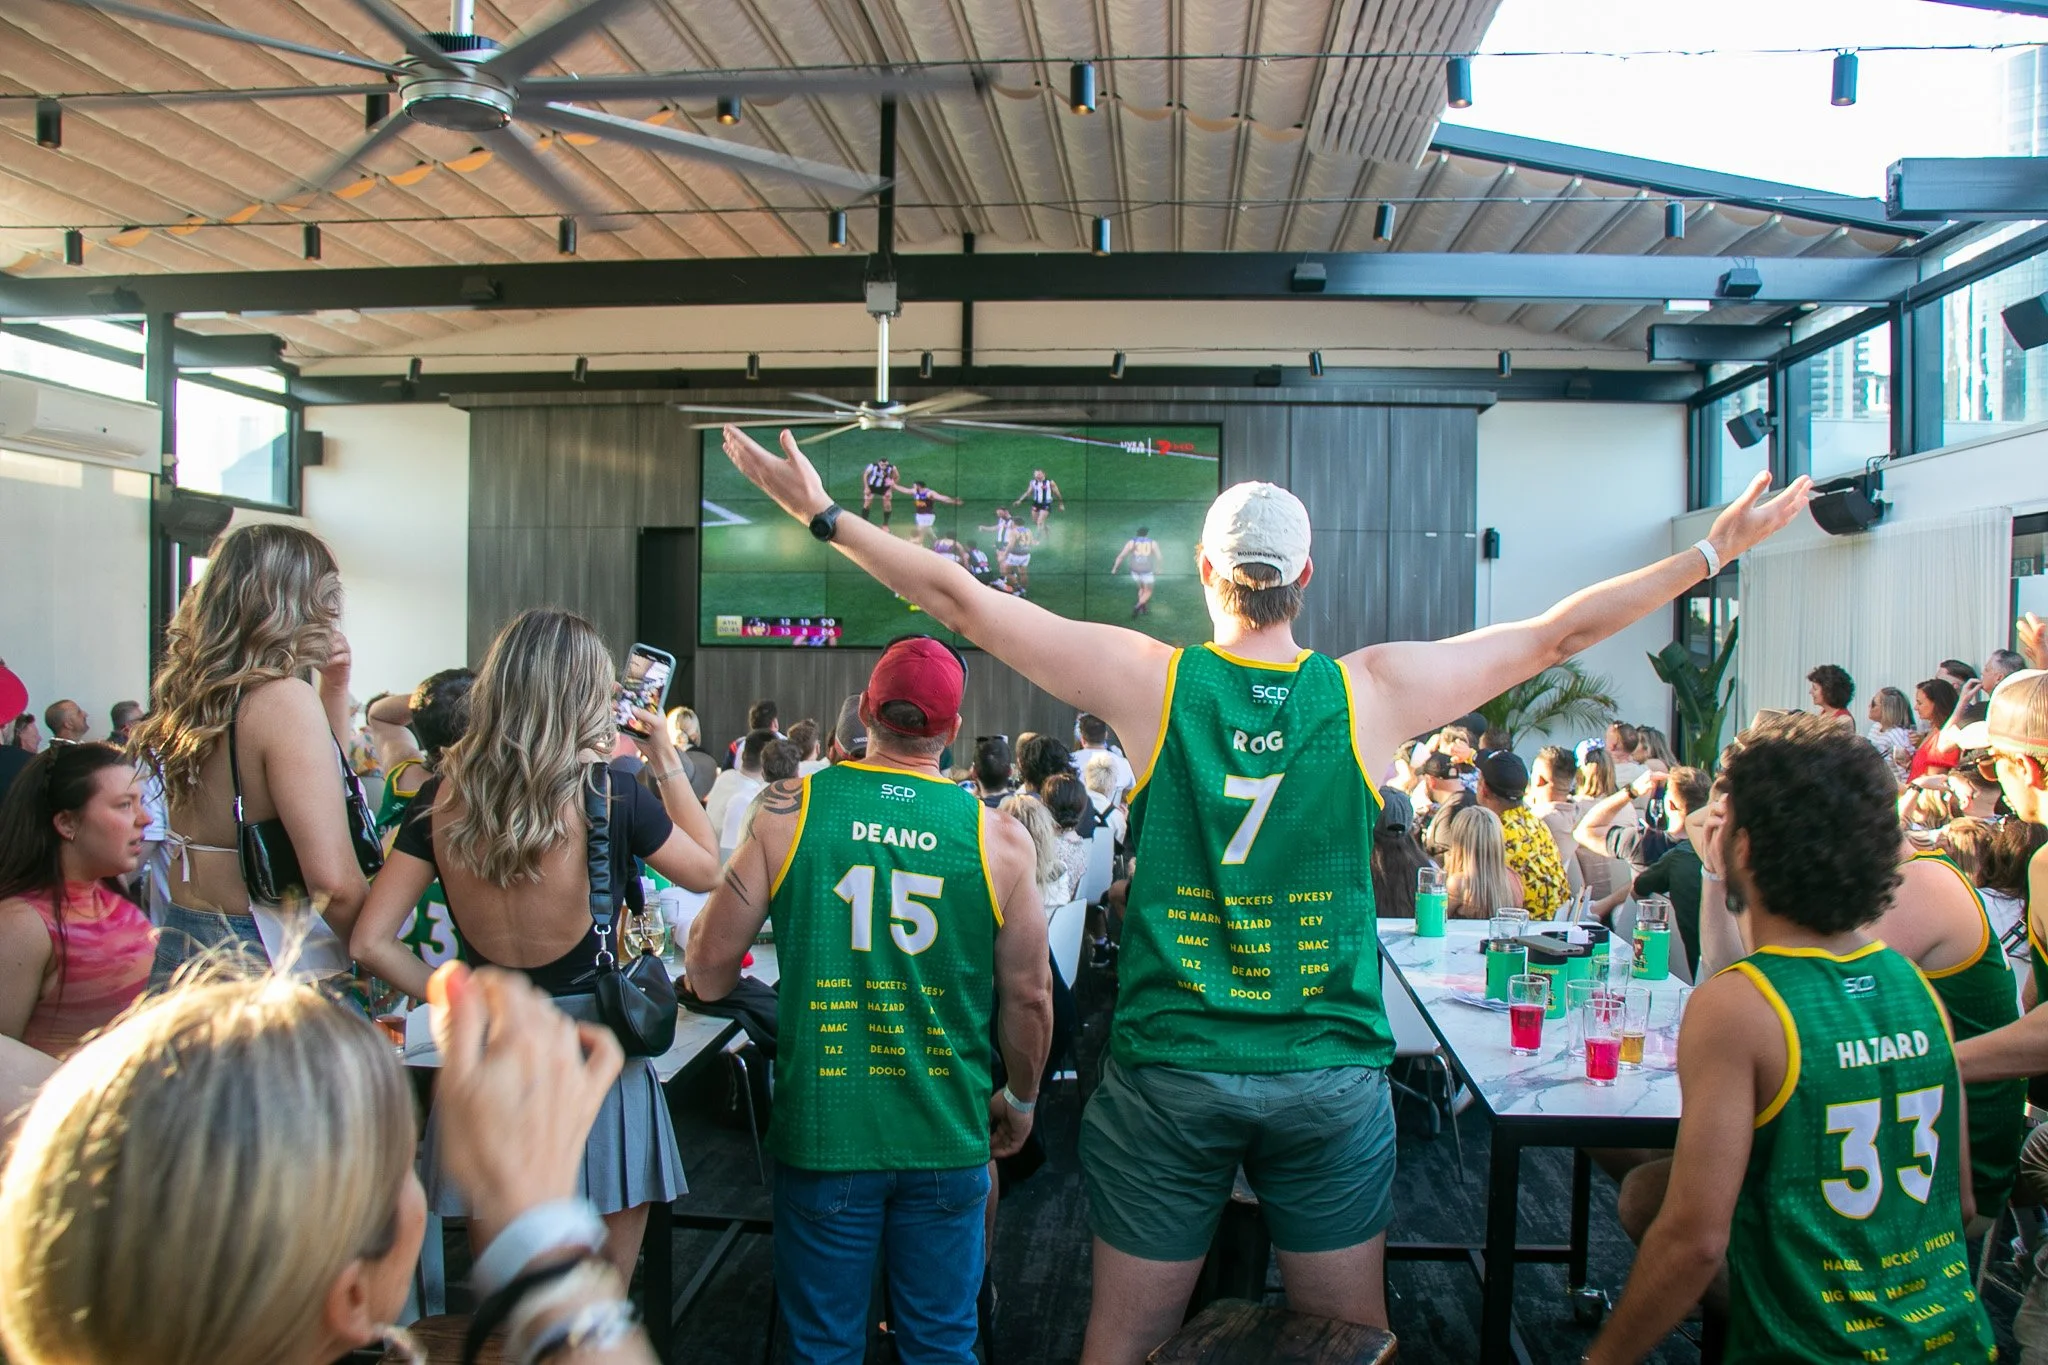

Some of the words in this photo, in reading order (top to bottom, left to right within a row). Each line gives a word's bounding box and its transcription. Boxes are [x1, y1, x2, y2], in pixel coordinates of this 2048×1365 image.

[780, 618, 791, 626] 12
[1252, 684, 1290, 700] SCD
[1232, 730, 1284, 754] ROG
[881, 783, 917, 798] SCD
[1221, 772, 1286, 866] 7
[852, 821, 937, 851] DEANO
[1177, 885, 1216, 900] HAGIEL
[1225, 895, 1274, 906] BUCKETS
[1289, 890, 1334, 903] DYKESY
[833, 864, 945, 957] 15
[1168, 909, 1187, 920] BIG
[1189, 911, 1221, 925] MARN
[1227, 918, 1272, 929] HAZARD
[1300, 915, 1324, 927] KEY
[1176, 934, 1210, 947] AMAC
[1230, 943, 1272, 954] HALLAS
[1298, 940, 1329, 951] SMAC
[1181, 958, 1202, 970] TAZ
[1232, 965, 1271, 977] DEANO
[1300, 963, 1329, 975] FERG
[816, 978, 853, 988] HAGIEL
[866, 980, 907, 991] BUCKETS
[1230, 988, 1272, 1000] DOOLO
[1303, 985, 1325, 997] ROG
[810, 1001, 828, 1011] BIG
[830, 1000, 858, 1010] MARN
[867, 1002, 905, 1012] HAZARD
[820, 1023, 848, 1033] AMAC
[869, 1023, 905, 1034] HALLAS
[824, 1045, 843, 1054] TAZ
[870, 1045, 906, 1056] DEANO
[926, 1046, 953, 1056] FERG
[1836, 1030, 1930, 1069] HAZARD
[819, 1067, 848, 1076] BMAC
[869, 1067, 906, 1077] DOOLO
[928, 1067, 950, 1077] ROG
[1821, 1084, 1945, 1221] 33
[1821, 1290, 1845, 1304] BIG
[1942, 1260, 1968, 1279] KEY
[1845, 1316, 1886, 1334] AMAC
[1862, 1348, 1890, 1362] TAZ
